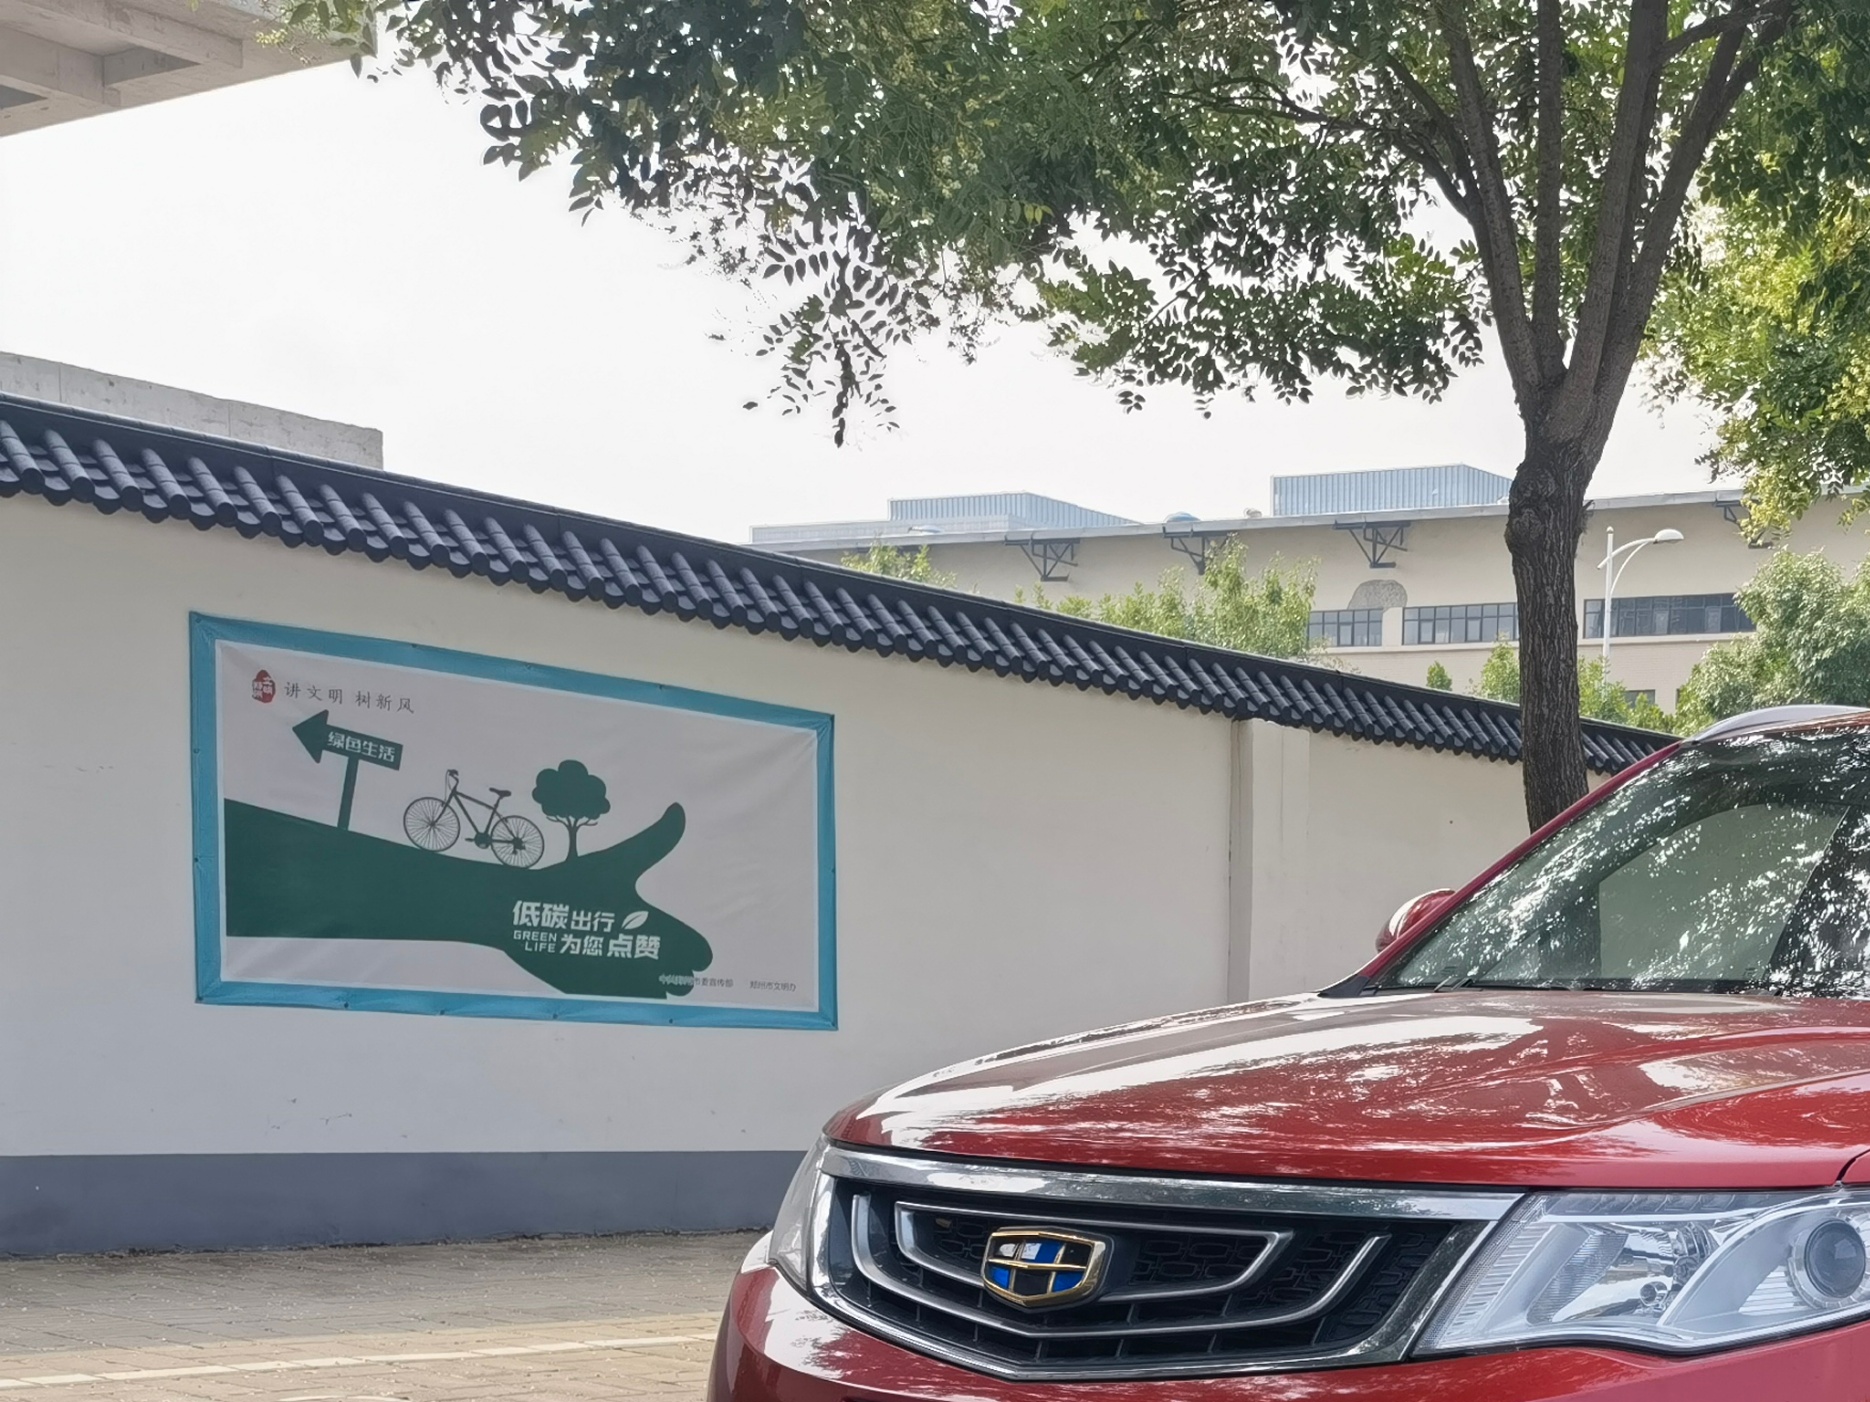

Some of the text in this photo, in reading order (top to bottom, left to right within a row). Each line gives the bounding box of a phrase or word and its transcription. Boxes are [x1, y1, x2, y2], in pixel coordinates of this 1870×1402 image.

[284, 681, 343, 705] 讲文明
[355, 690, 415, 714] 树新风
[327, 731, 396, 763] 绿色生活
[512, 900, 615, 933] 低碳出行
[513, 930, 557, 942] GREEN
[524, 941, 556, 953] LIFE
[559, 933, 661, 960] 为您点赞
